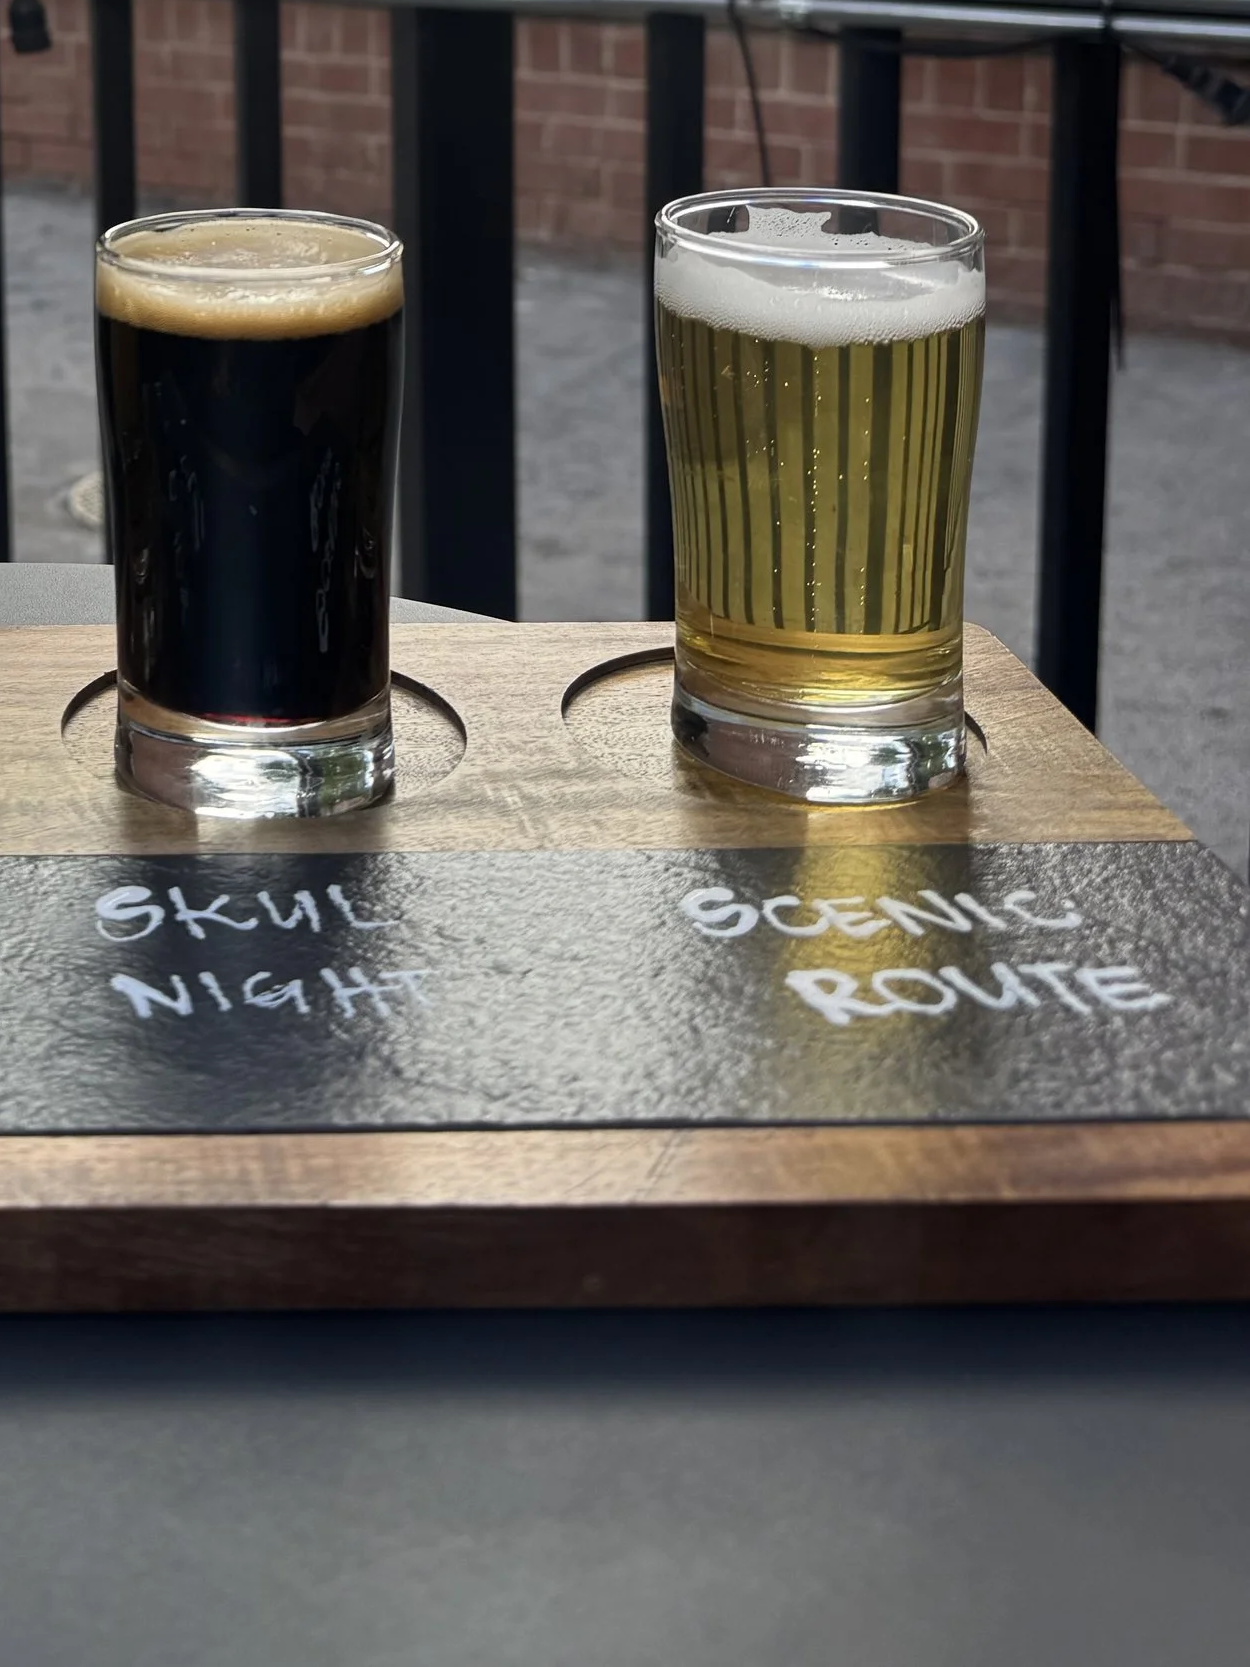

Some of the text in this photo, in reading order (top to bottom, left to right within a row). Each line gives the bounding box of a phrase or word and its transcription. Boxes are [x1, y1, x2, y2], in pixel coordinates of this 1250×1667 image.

[679, 887, 1082, 937] SCENIC
[110, 966, 442, 1018] NIGHT
[784, 961, 1175, 1026] ROUTE
